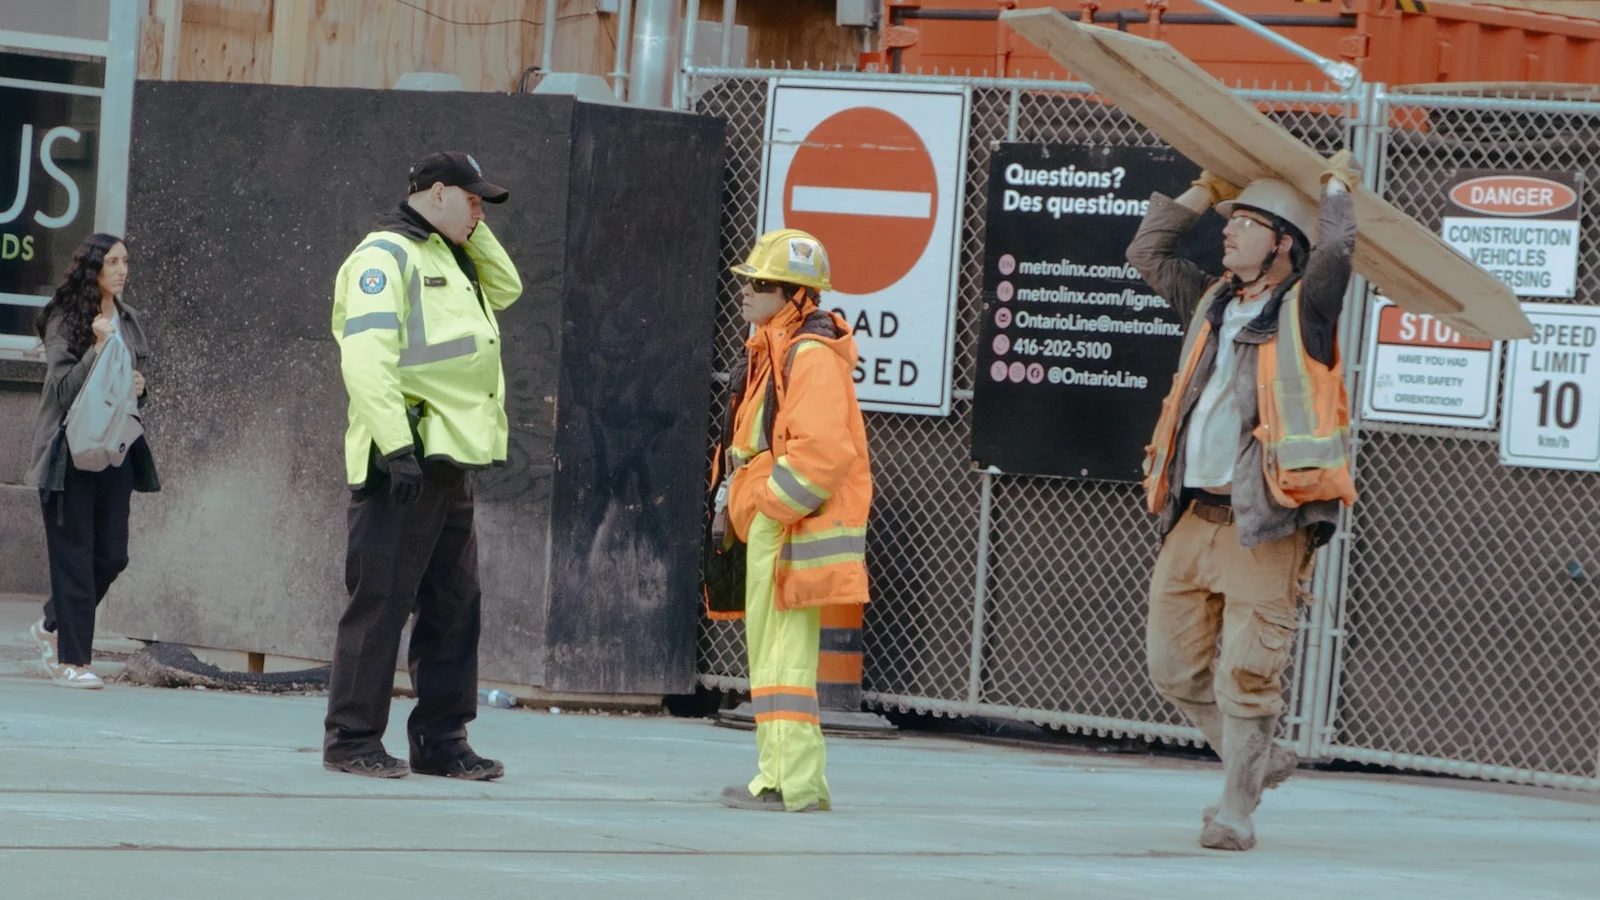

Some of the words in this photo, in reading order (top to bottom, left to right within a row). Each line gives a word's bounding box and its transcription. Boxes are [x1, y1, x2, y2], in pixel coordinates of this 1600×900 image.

[1004, 162, 1126, 189] Questions?
[1003, 189, 1043, 212] Des
[1046, 192, 1150, 219] questions
[1470, 186, 1554, 206] DANGER
[1448, 225, 1572, 246] CONSTRUCTION
[1, 233, 35, 262] DS
[1470, 247, 1547, 267] VEHICLES
[1489, 269, 1551, 288] ERSING
[831, 308, 899, 338] AD
[1399, 312, 1460, 344] STO
[1530, 323, 1596, 347] SPEED
[1012, 338, 1112, 360] 416-202-5100
[851, 356, 918, 387] SED
[1397, 354, 1422, 365] HAVE
[1424, 355, 1445, 366] YOU
[1447, 357, 1468, 367] HAD
[1531, 350, 1590, 375] LIMIT
[1047, 367, 1148, 389] @OntarioLine
[1398, 374, 1425, 384] YOUR
[1427, 375, 1464, 387] SAFETY
[1394, 393, 1464, 406] ORIENTATION?
[1532, 380, 1581, 429] 10
[1538, 434, 1570, 448] km/h
